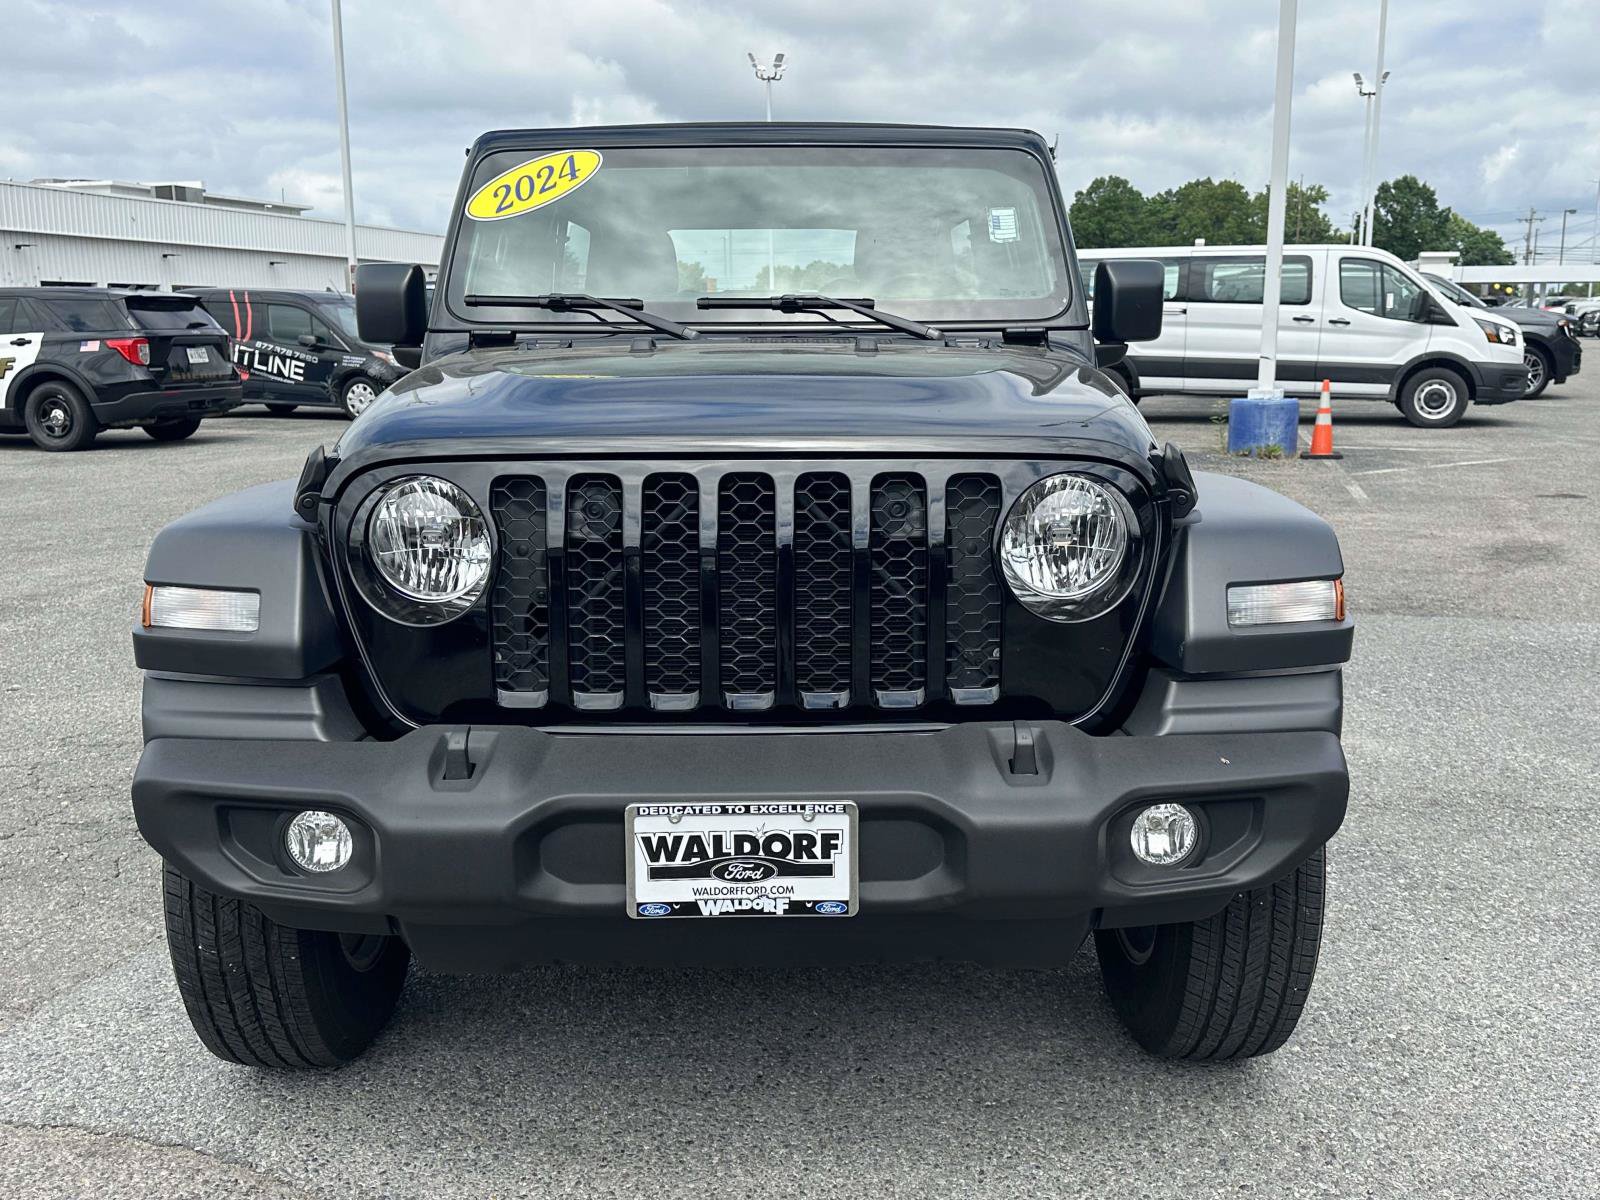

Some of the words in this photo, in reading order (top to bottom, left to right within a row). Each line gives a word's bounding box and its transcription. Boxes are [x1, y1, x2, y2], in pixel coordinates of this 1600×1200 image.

[493, 154, 581, 214] 2024
[639, 806, 722, 816] DEDICATED
[726, 805, 746, 815] TO
[749, 804, 845, 814] EXCELLENCE
[639, 832, 840, 863] WALDORF
[724, 863, 765, 881] Ford
[692, 885, 795, 897] WALDORFFORD.COM
[696, 897, 790, 916] WALDORF
